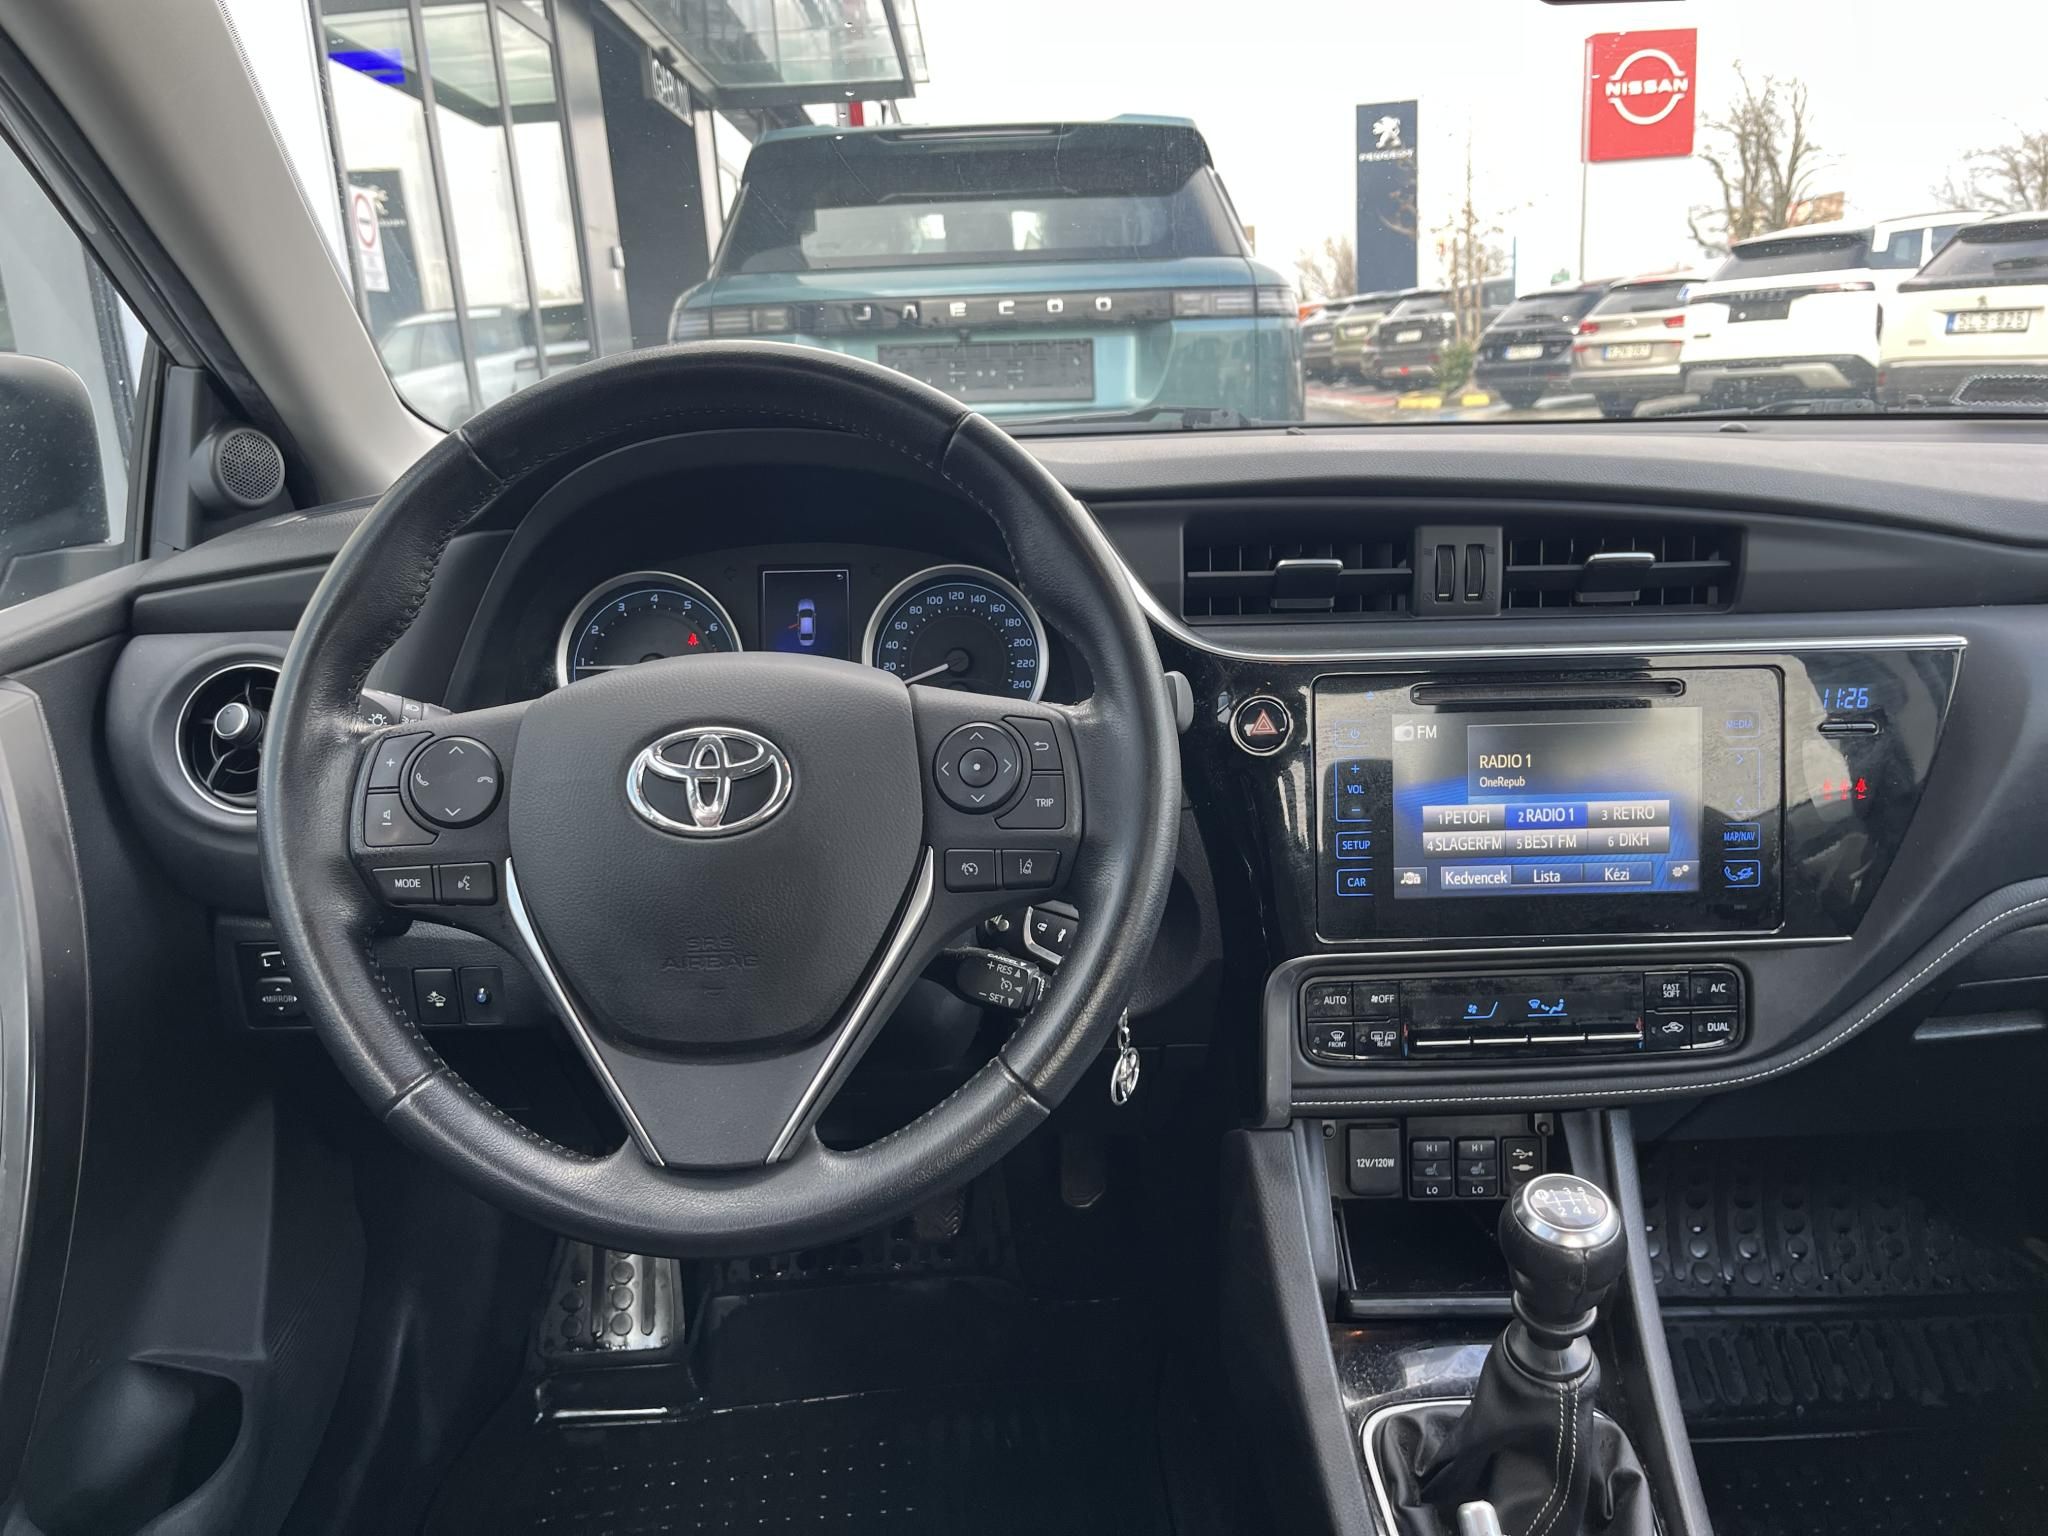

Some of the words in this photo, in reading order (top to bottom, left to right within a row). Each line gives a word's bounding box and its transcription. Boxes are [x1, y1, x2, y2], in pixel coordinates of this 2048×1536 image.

[1605, 78, 1688, 96] NISSAN
[856, 297, 1112, 320] JAECOO
[651, 594, 659, 602] 4
[926, 596, 943, 605] 100
[948, 592, 964, 600] 120
[970, 595, 986, 603] 140
[618, 603, 625, 612] 3
[684, 601, 692, 609] 5
[909, 606, 922, 614] 80
[990, 604, 1006, 612] 160
[710, 623, 718, 632] 6
[895, 622, 908, 630] 60
[1005, 618, 1021, 627] 180
[591, 626, 599, 634] 2
[885, 640, 899, 649] 40
[1013, 639, 1032, 647] 200
[884, 663, 897, 671] 20
[1016, 660, 1035, 668] 220
[1013, 680, 1031, 689] 240
[1824, 688, 1868, 709] 11:26
[1726, 719, 1754, 729] MEDIA
[1417, 726, 1437, 738] FM
[1479, 754, 1522, 769] RADIO
[1525, 754, 1532, 768] 1
[1479, 775, 1526, 789] OneRepub
[1347, 785, 1365, 794] VOL
[1035, 798, 1054, 808] TRIP
[1527, 808, 1566, 823] RADIO
[1568, 808, 1575, 821] 1
[1602, 810, 1608, 821] 3
[1613, 807, 1655, 821] RETRO
[1608, 836, 1615, 847] 6
[1619, 832, 1649, 847] DIKH
[1724, 831, 1755, 841] MAP/NAV
[1342, 840, 1371, 850] SETUP
[1435, 837, 1502, 852] SLAGERFM
[1525, 835, 1553, 849] BEST
[1558, 834, 1577, 848] FM
[1445, 870, 1508, 885] Kedvencek
[1533, 869, 1561, 883] Lista
[1605, 867, 1630, 881] Kézi
[394, 879, 421, 888] MODE
[1347, 877, 1366, 887] CAR
[987, 953, 1018, 965] CANCEL
[996, 963, 1013, 975] RES
[1662, 983, 1680, 991] FAST
[1711, 983, 1726, 993] A/C
[988, 992, 1005, 1004] SET
[1323, 995, 1347, 1005] AUTO
[1378, 994, 1395, 1003] OFF
[1707, 1022, 1730, 1032] DUAL
[1426, 1144, 1438, 1152] HI
[1471, 1144, 1483, 1152] HI
[1356, 1158, 1395, 1168] 12V/120W
[1426, 1186, 1439, 1195] LO
[1472, 1186, 1484, 1194] LO
[1559, 1207, 1568, 1217] 2
[1573, 1206, 1582, 1216] 4
[1587, 1206, 1597, 1215] 6
